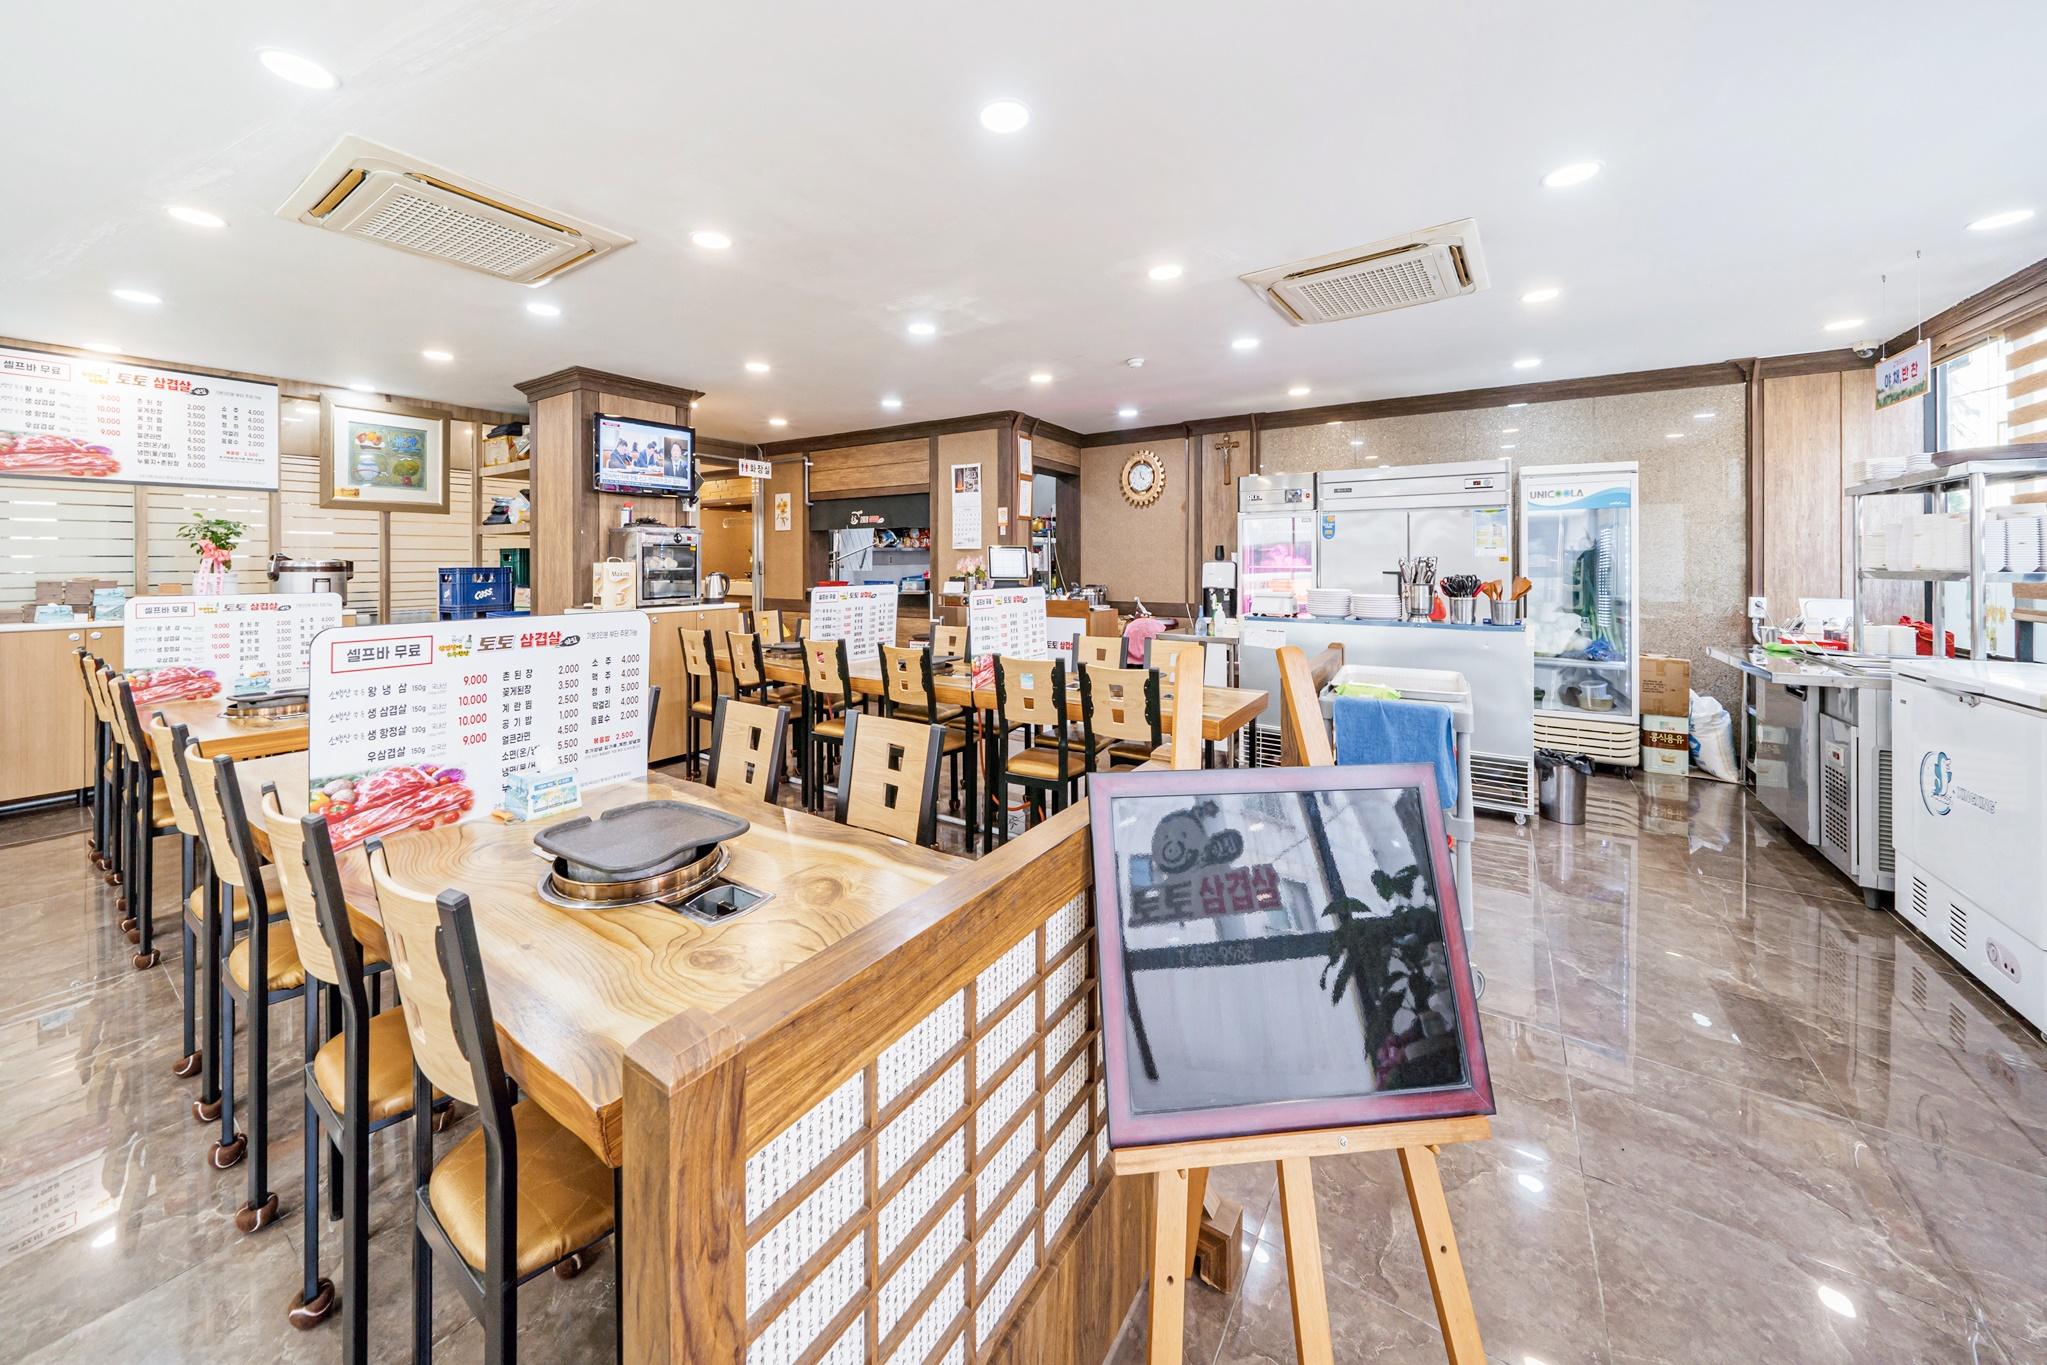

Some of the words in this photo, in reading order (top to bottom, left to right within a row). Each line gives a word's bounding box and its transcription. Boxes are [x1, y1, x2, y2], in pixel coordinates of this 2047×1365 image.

[115, 372, 147, 387] 토토
[153, 376, 191, 393] 삼겹살
[750, 464, 770, 475] 화장실
[611, 570, 630, 578] Maxim
[250, 602, 278, 611] 삼겹살
[477, 634, 514, 652] 토토
[520, 630, 562, 649] 삼겹살
[347, 646, 389, 663] 셀프바
[394, 644, 421, 658] 무료
[621, 654, 640, 664] 4,000
[558, 664, 580, 676] 2,000
[621, 668, 640, 678] 4,000
[412, 684, 426, 693] 150g
[463, 673, 488, 686] 9,000
[502, 684, 531, 698] 꽃게된장
[558, 678, 579, 690] 3,500
[620, 681, 640, 692] 5,000
[367, 707, 376, 720] 생
[379, 704, 407, 717] 삼겹살
[412, 705, 426, 713] 150g
[458, 693, 488, 706] 10,000
[558, 693, 579, 705] 2,500
[592, 699, 611, 711] 막걸리
[620, 695, 639, 706] 4,000
[559, 708, 579, 720] 1,000
[590, 715, 611, 726] 음료수
[620, 709, 639, 720] 2,000
[367, 729, 376, 742] 생
[379, 724, 407, 739] 항정살
[458, 713, 487, 727] 10,000
[502, 731, 531, 746] 얼큰라면
[557, 723, 579, 735] 4,500
[615, 730, 634, 740] 2,500
[367, 746, 406, 763] 우삼겹살
[411, 747, 426, 756] 150g
[462, 732, 487, 746] 9,000
[557, 738, 578, 750] 5,500
[1128, 880, 1194, 928] 토토
[1200, 863, 1284, 915] 삼겹살
